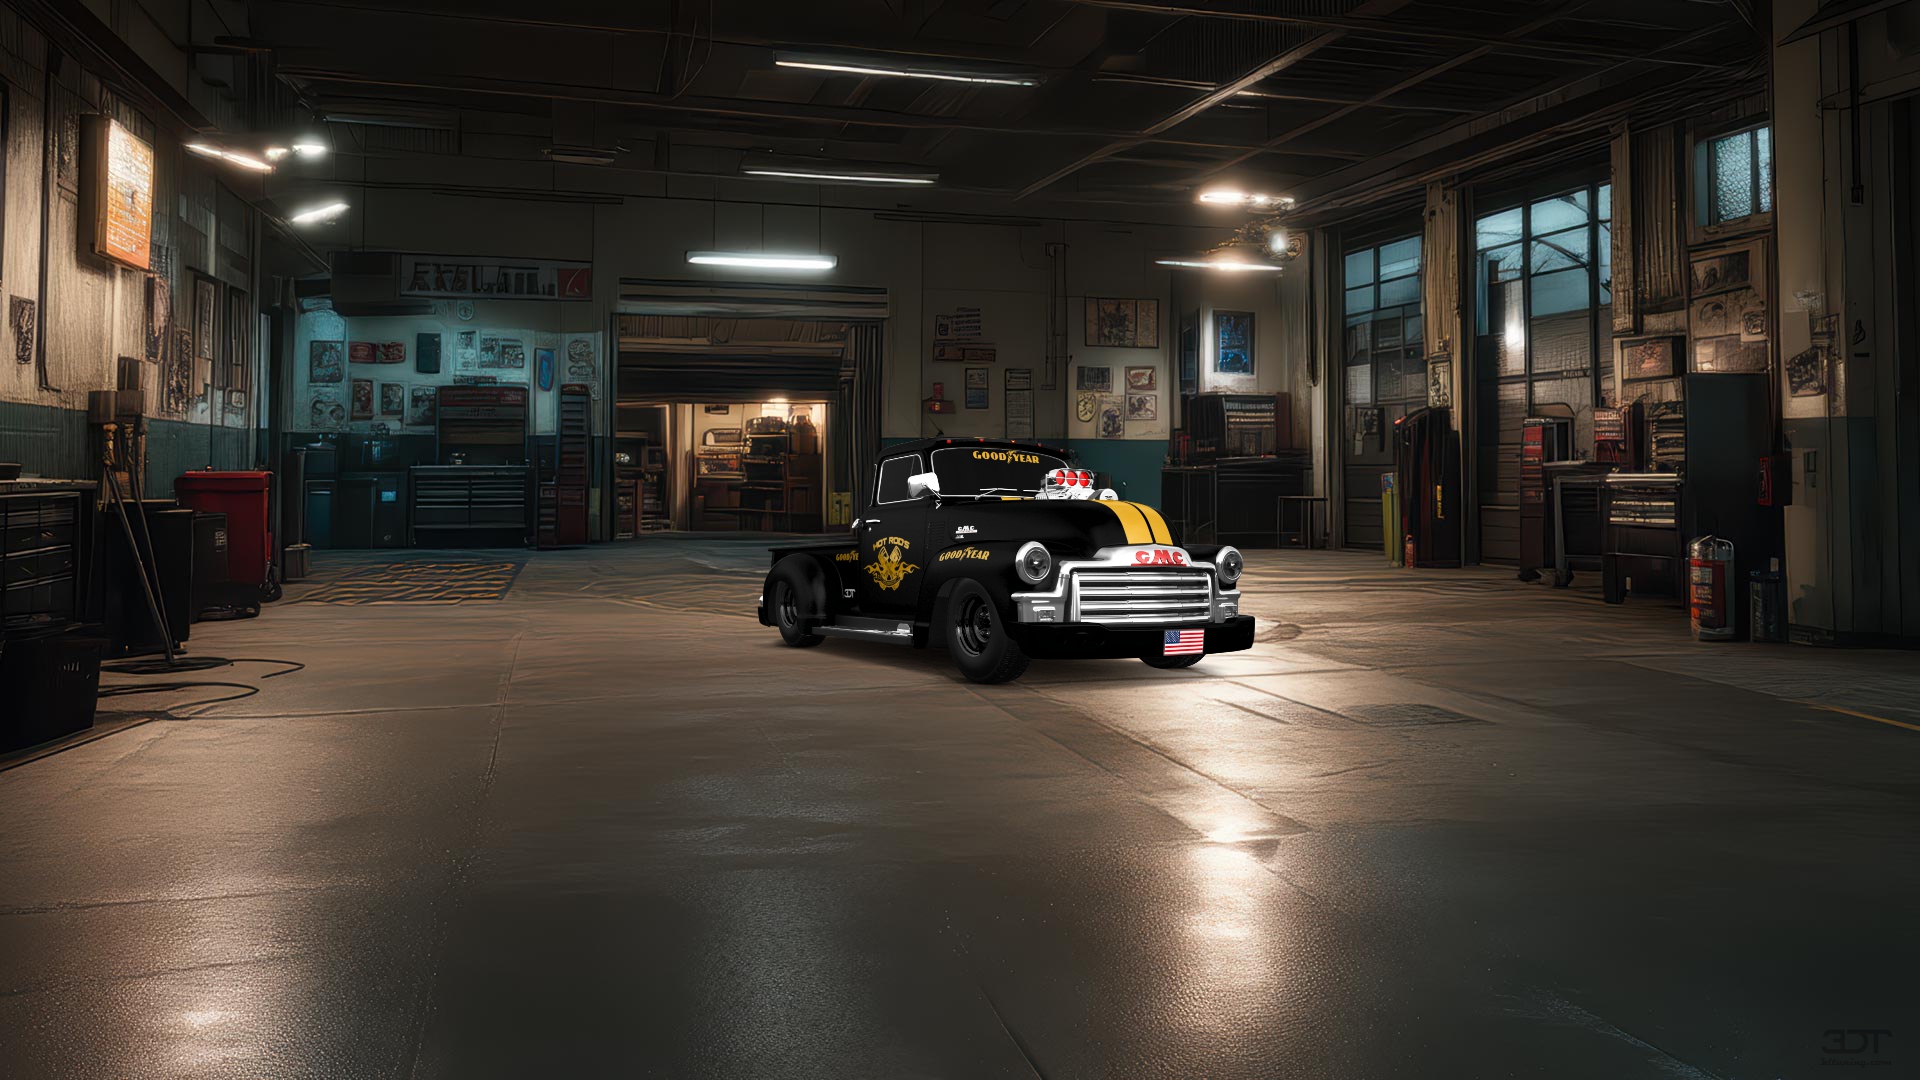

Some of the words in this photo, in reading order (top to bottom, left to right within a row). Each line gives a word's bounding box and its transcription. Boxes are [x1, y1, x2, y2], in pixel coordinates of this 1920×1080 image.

[972, 450, 1040, 464] GOODYEAR
[872, 537, 888, 551] HOT
[939, 546, 990, 562] GOODYEAR
[1134, 549, 1184, 566] GMC
